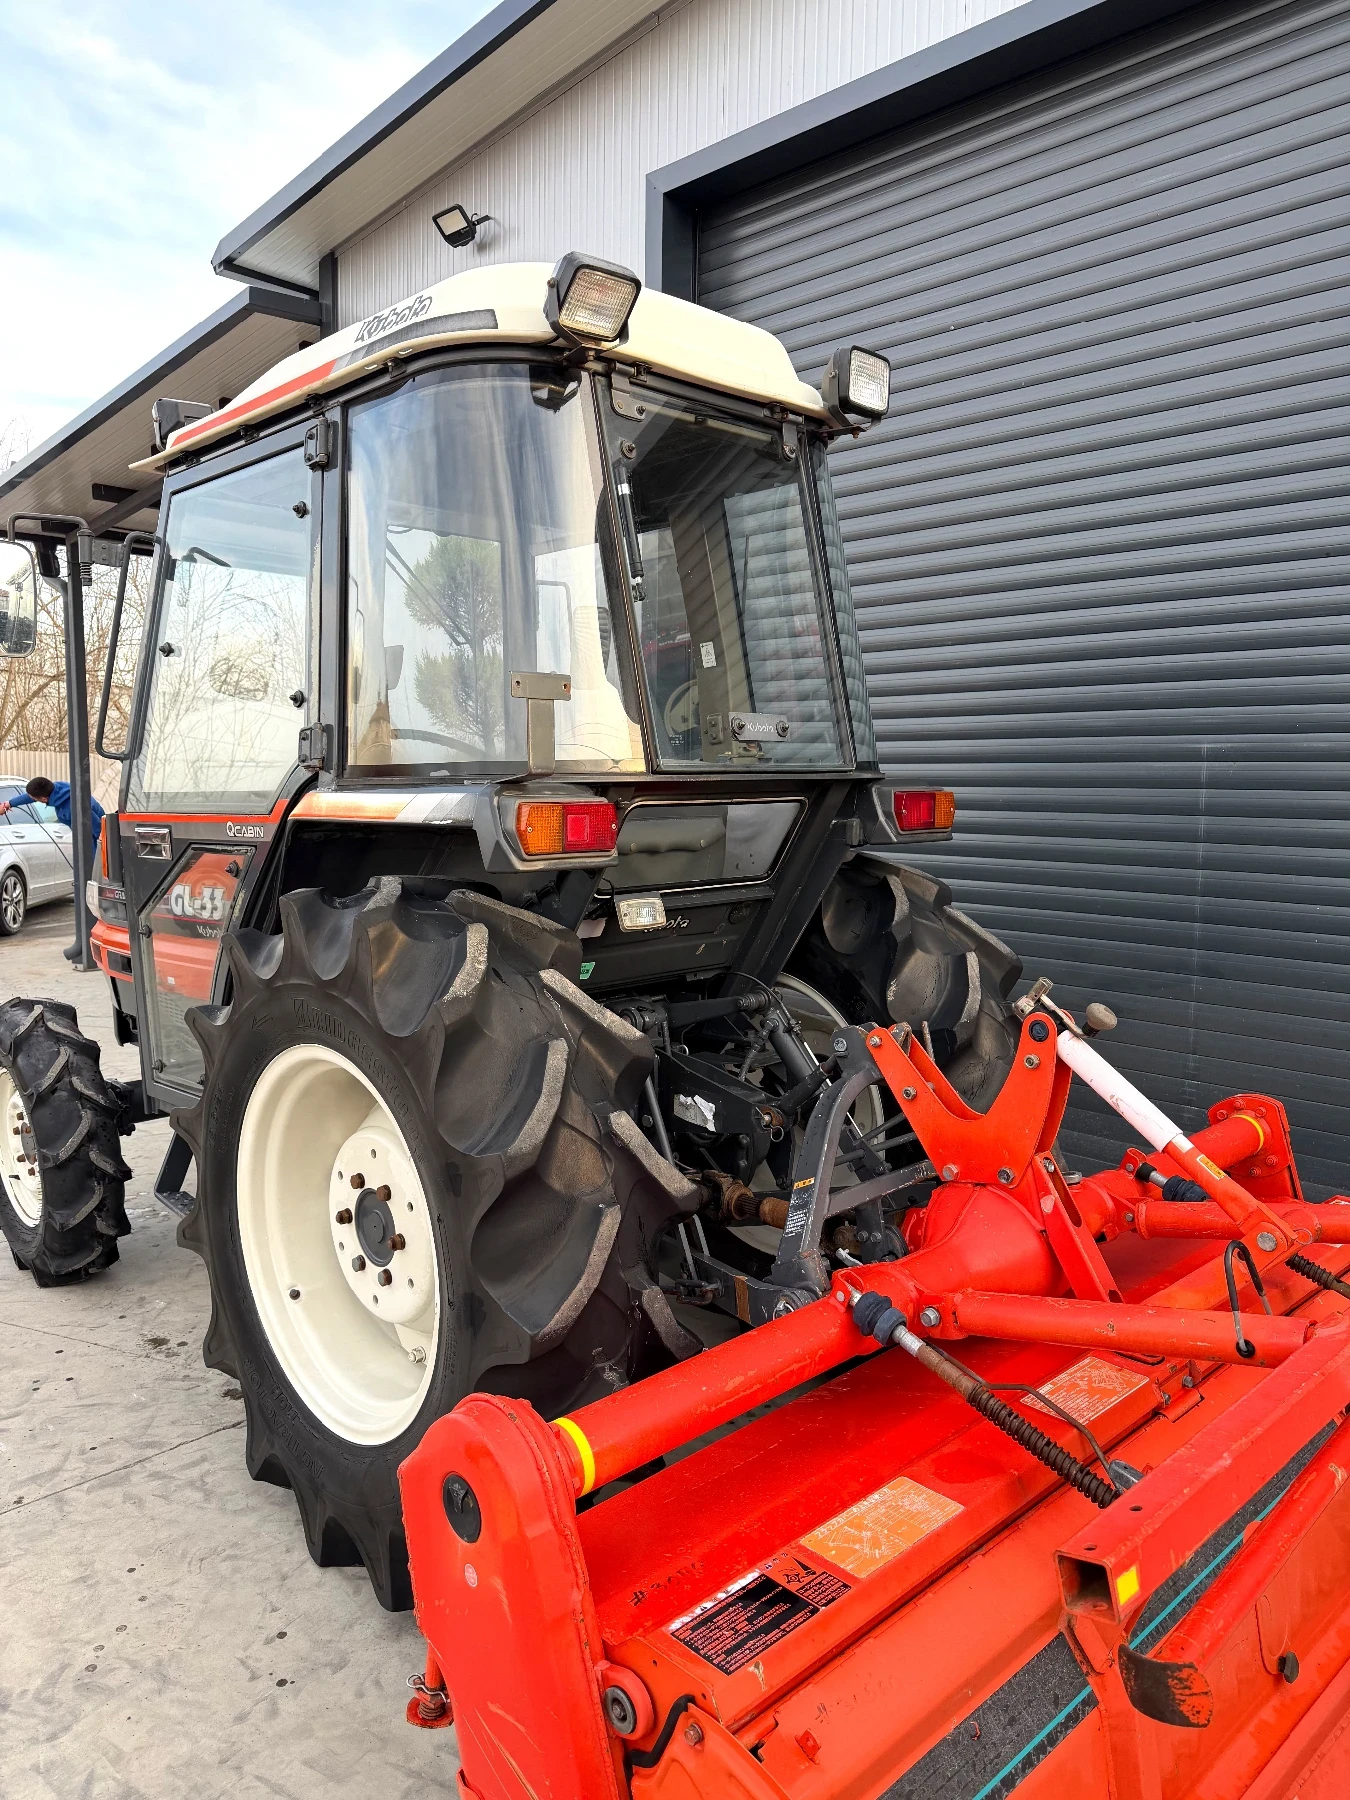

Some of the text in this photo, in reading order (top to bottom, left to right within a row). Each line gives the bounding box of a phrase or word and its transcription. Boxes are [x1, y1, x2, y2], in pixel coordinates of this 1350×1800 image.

[354, 294, 434, 343] Kubota
[746, 722, 774, 732] Kubota
[170, 883, 227, 921] GL-33
